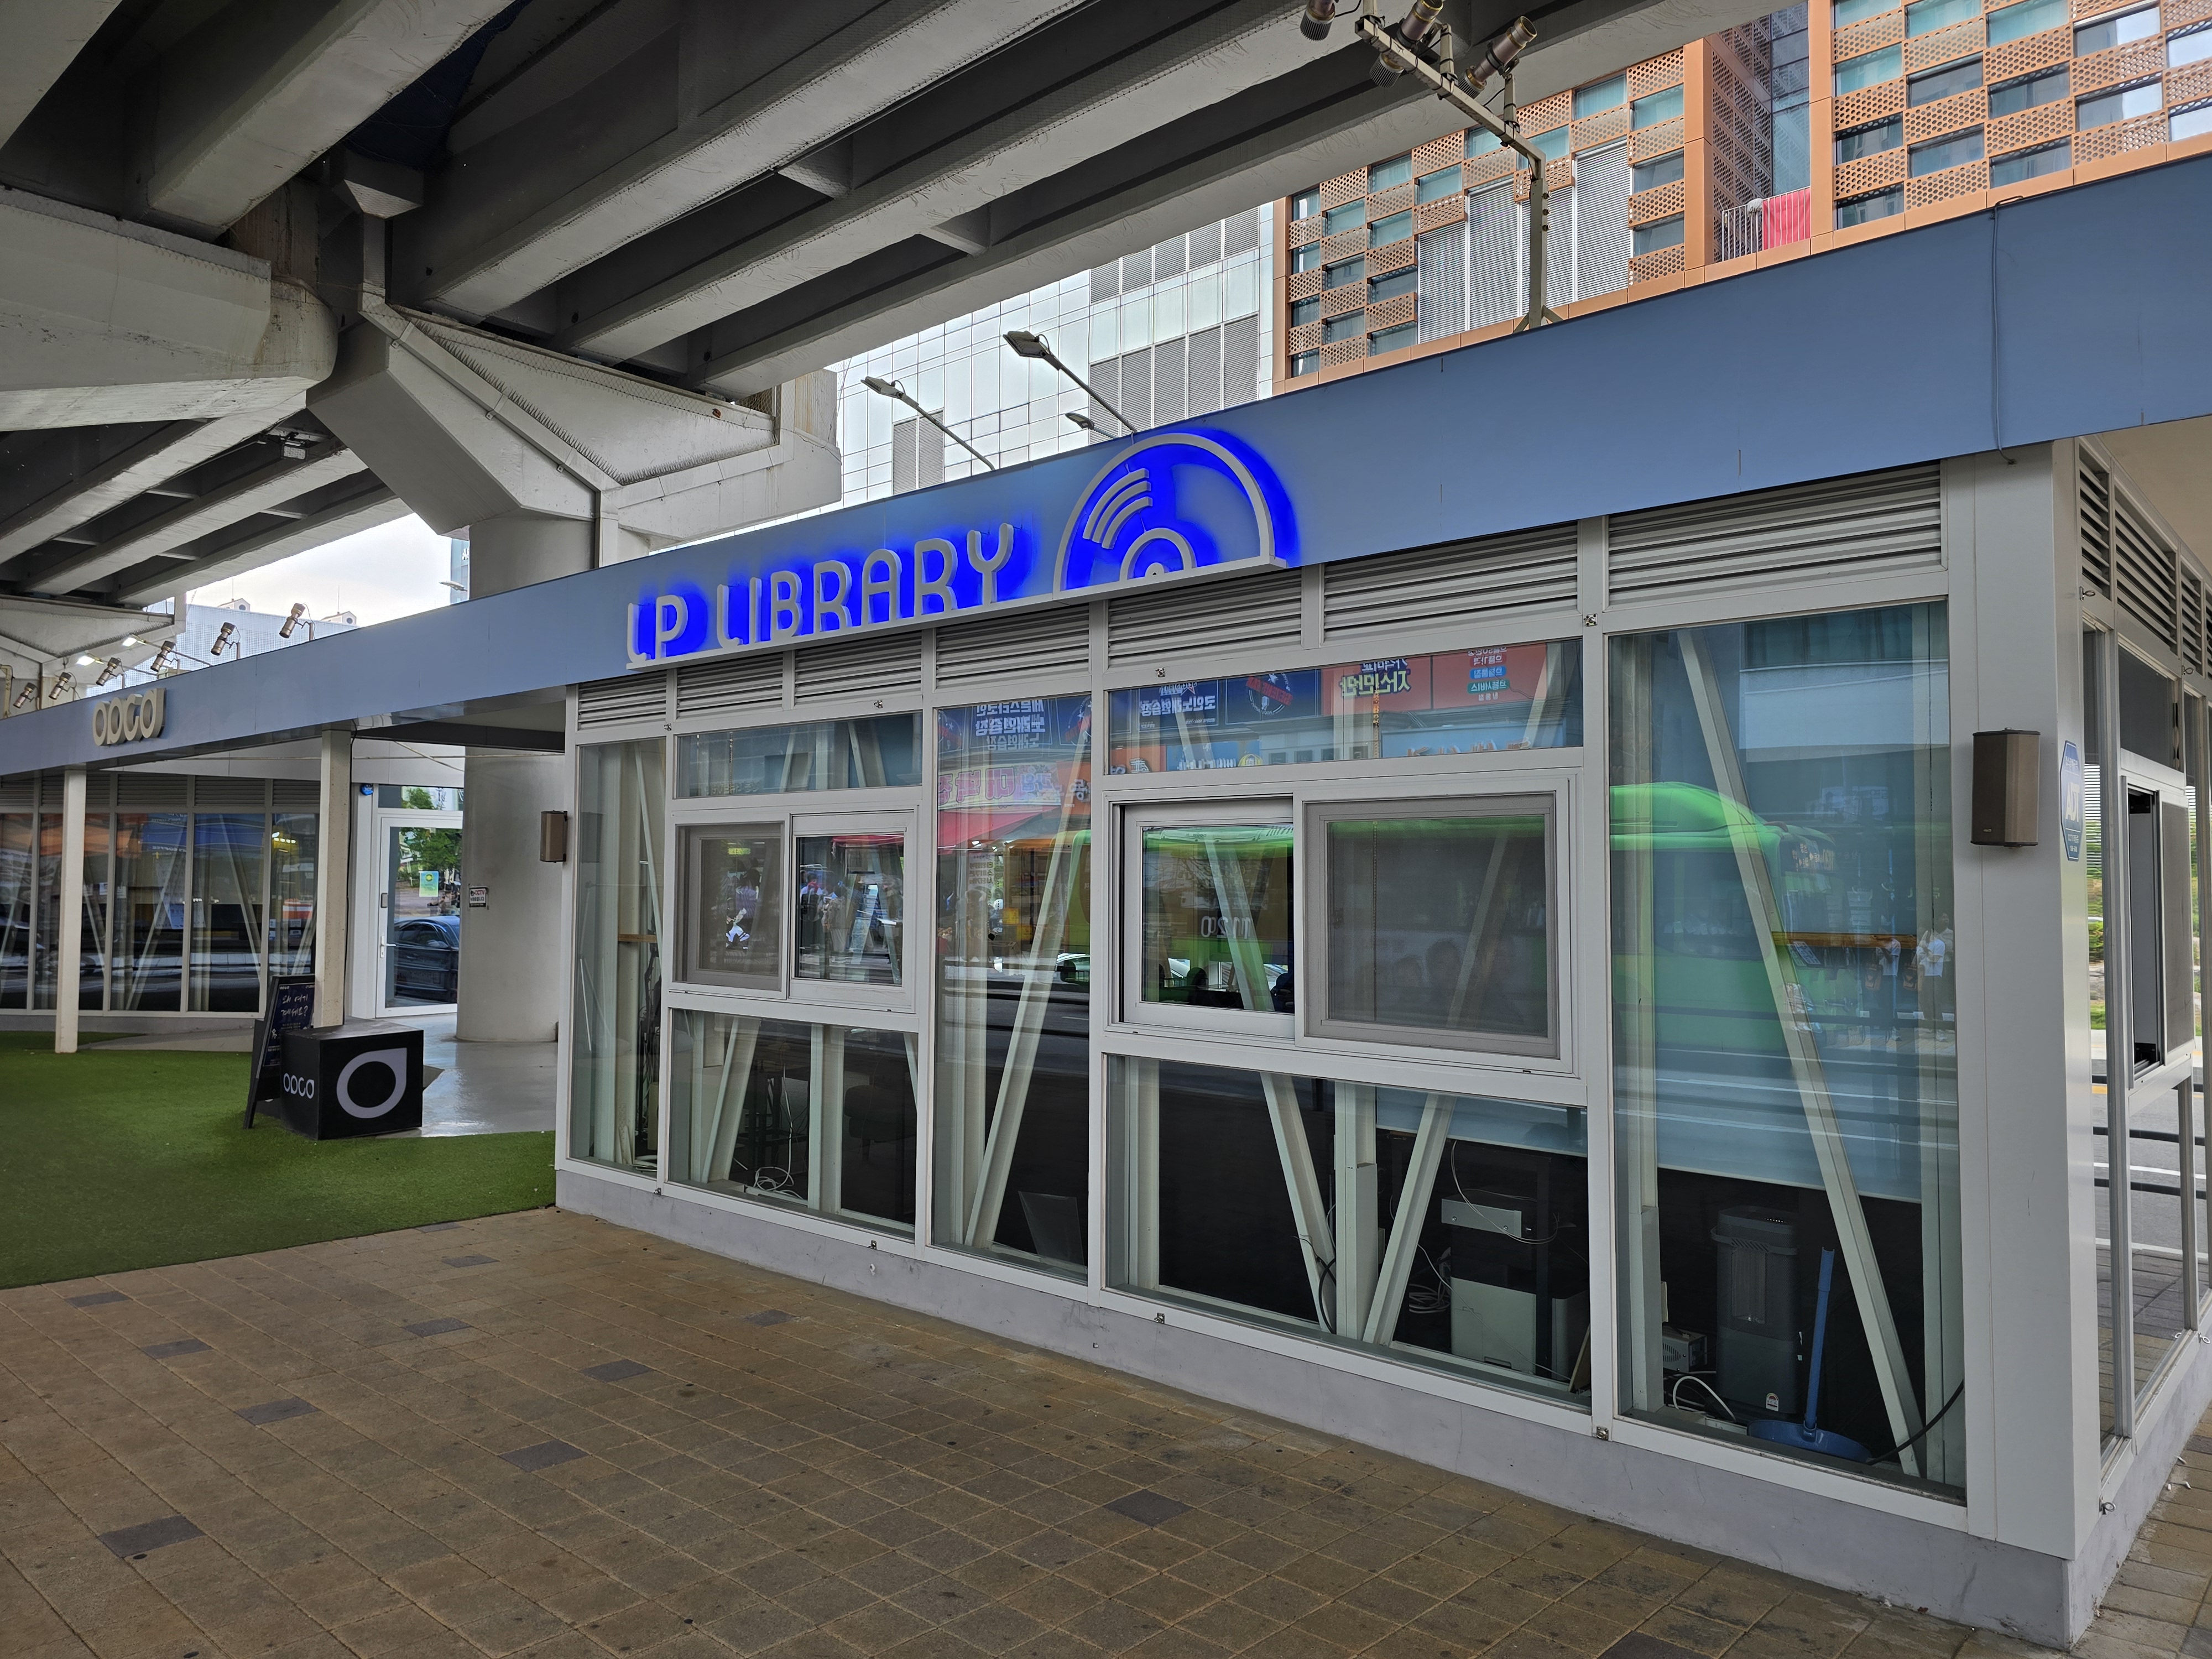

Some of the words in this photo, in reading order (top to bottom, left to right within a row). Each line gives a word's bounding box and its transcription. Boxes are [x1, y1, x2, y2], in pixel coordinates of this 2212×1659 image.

[627, 594, 687, 662] LP
[716, 523, 1014, 649] LIBRARY
[2065, 781, 2080, 822] ADT
[294, 994, 309, 1003] 여기
